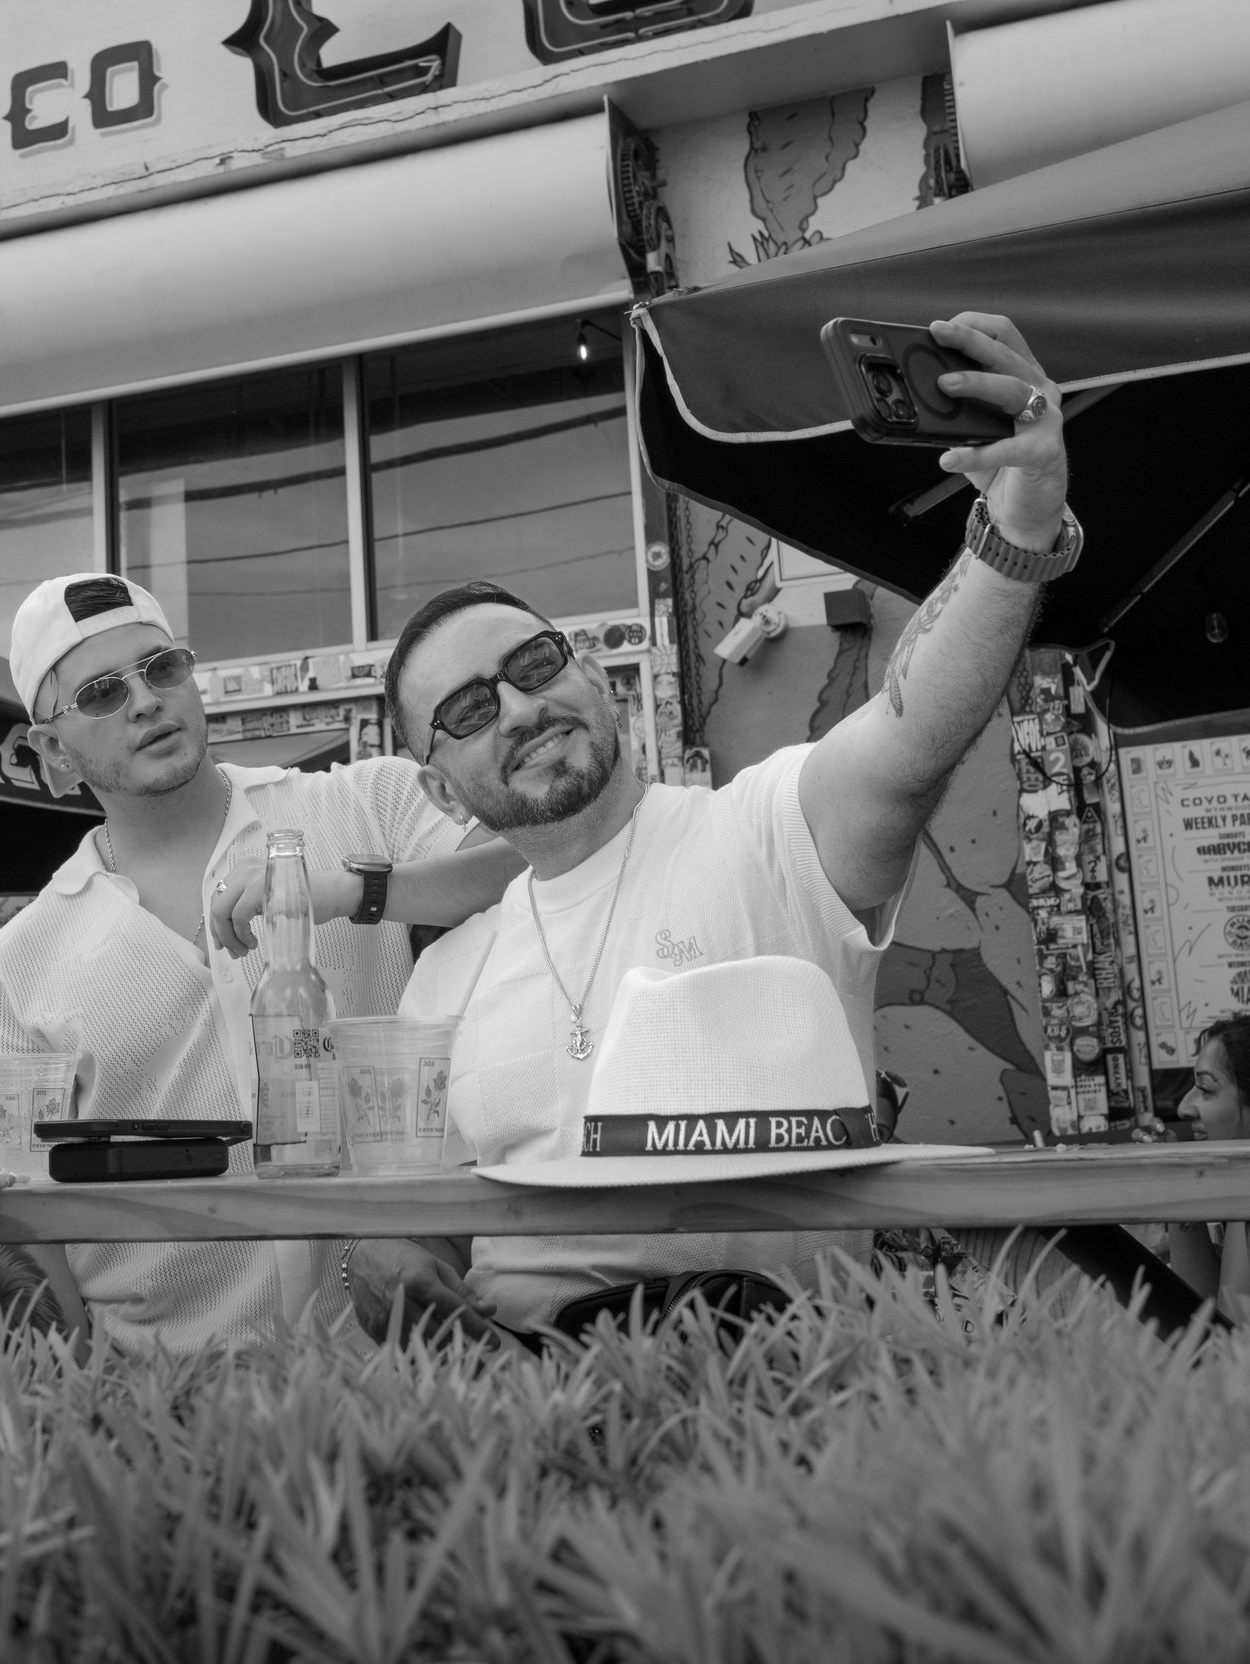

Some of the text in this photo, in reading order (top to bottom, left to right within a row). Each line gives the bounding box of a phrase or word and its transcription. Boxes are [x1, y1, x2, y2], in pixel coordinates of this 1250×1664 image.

[1181, 795, 1227, 807] COYO
[1182, 814, 1227, 831] WEEKLY
[1218, 831, 1246, 840] SUNDAYS
[645, 1117, 757, 1151] MIAMI
